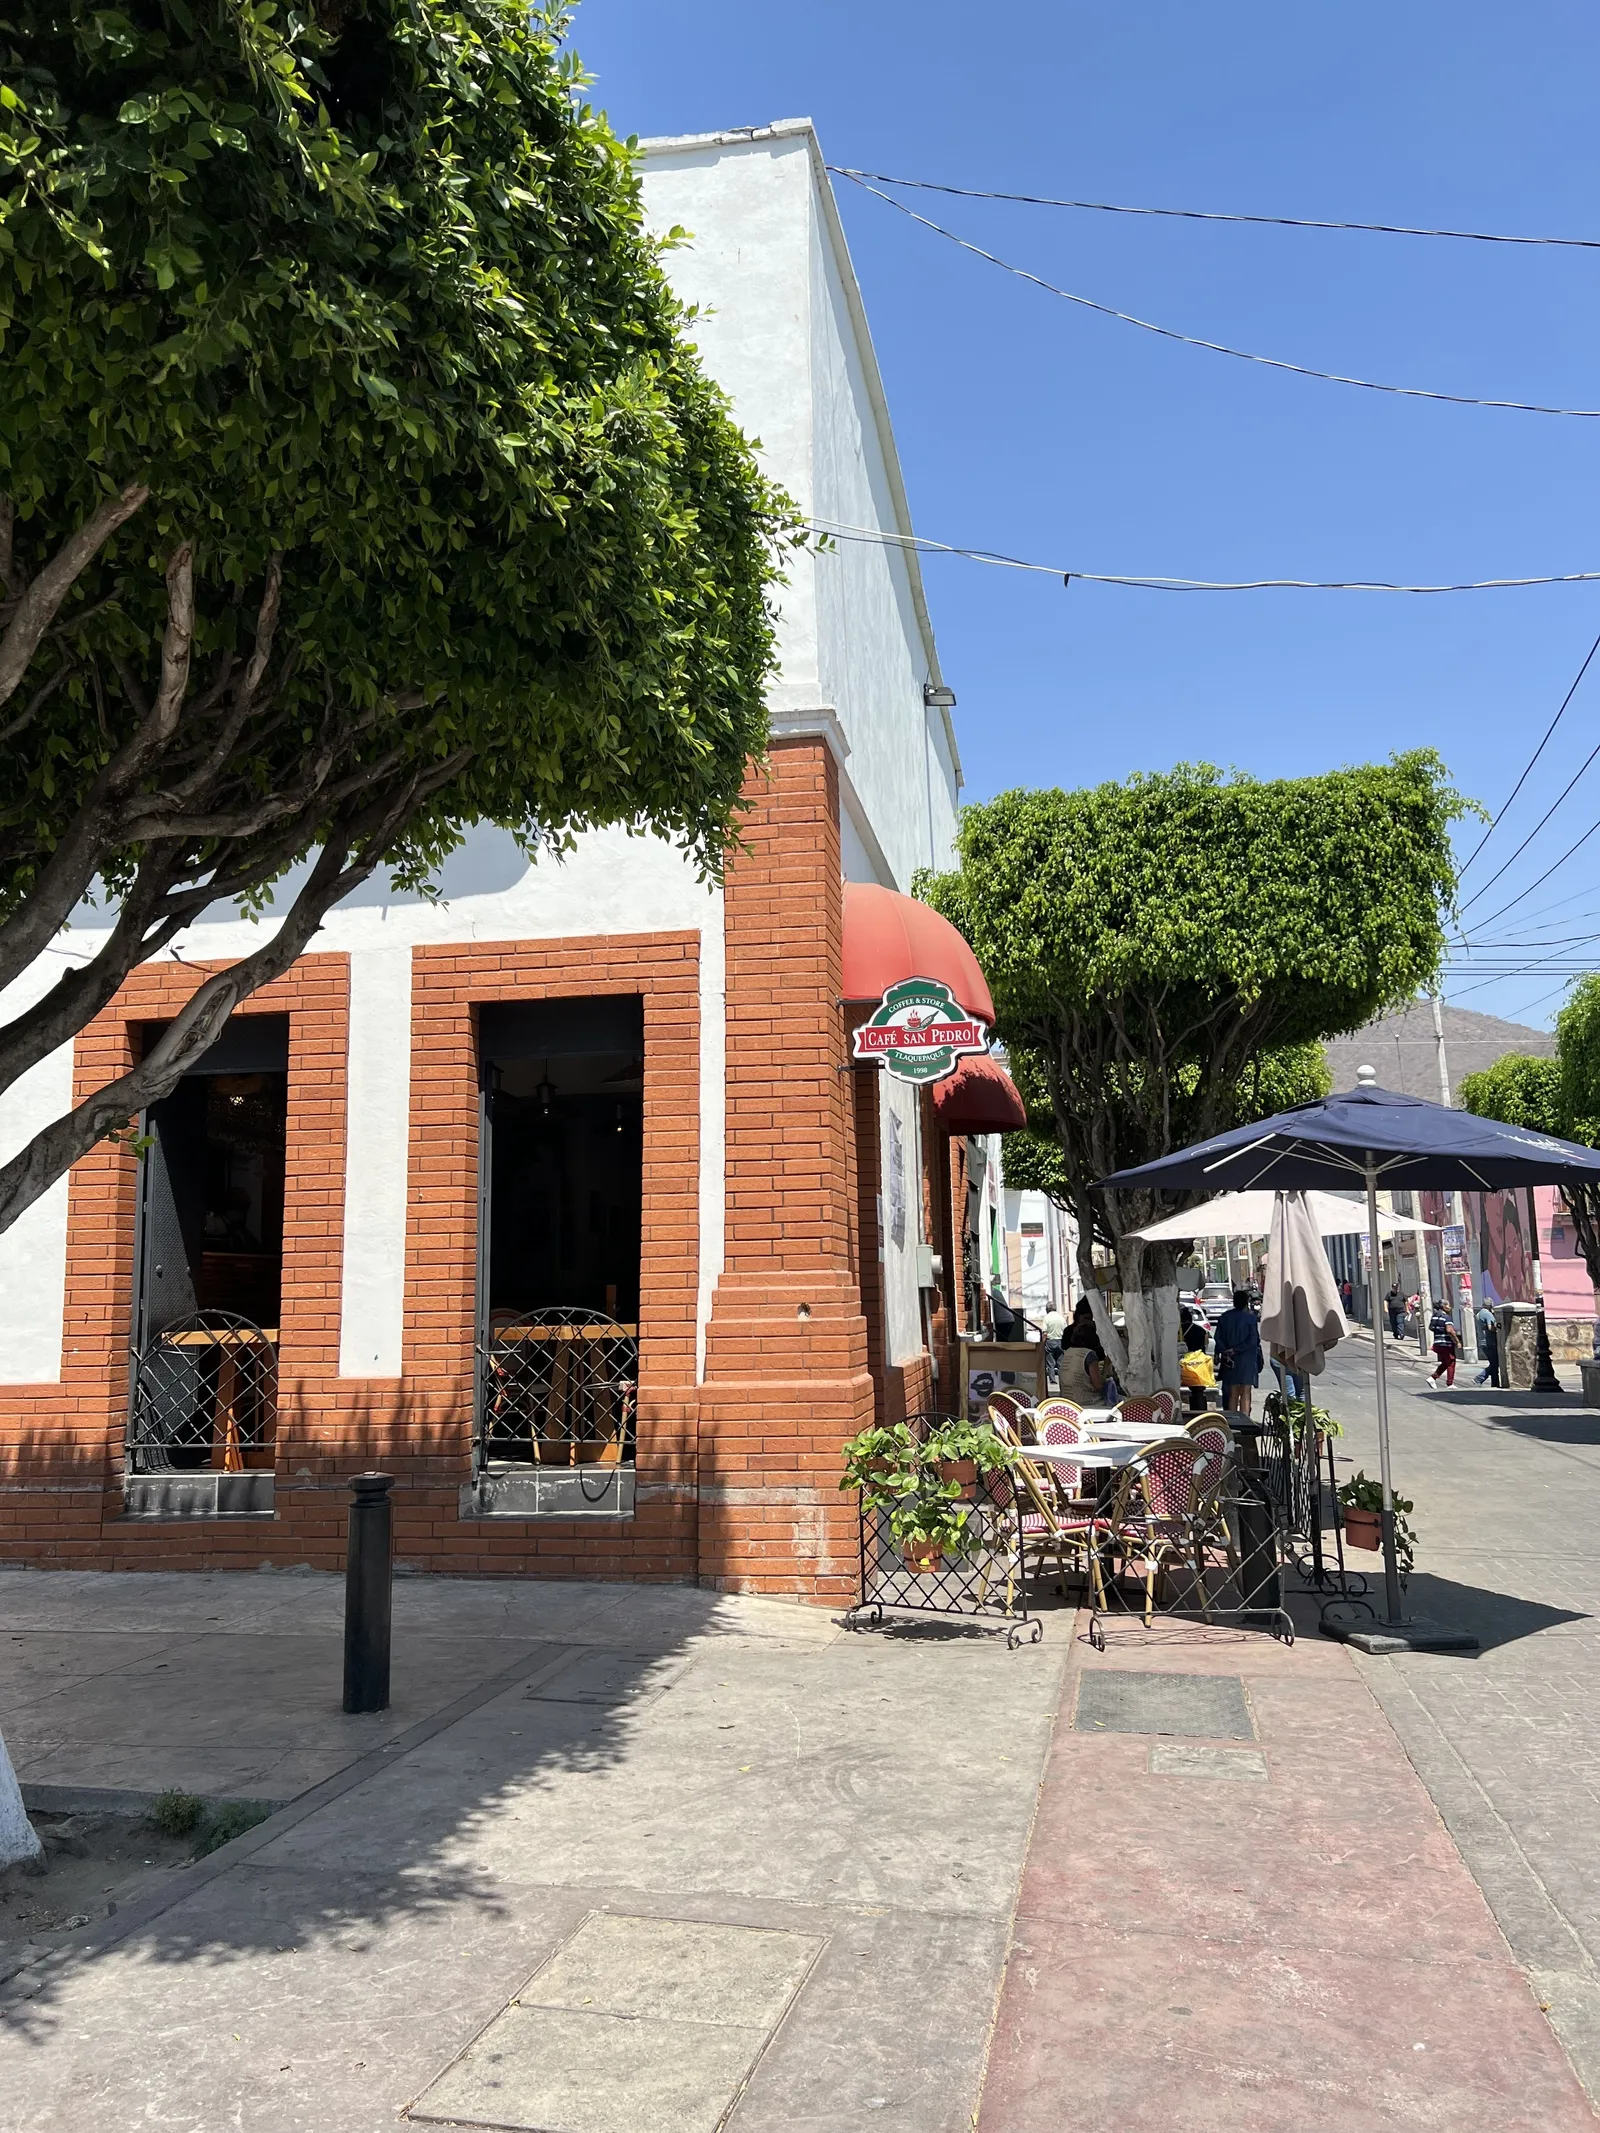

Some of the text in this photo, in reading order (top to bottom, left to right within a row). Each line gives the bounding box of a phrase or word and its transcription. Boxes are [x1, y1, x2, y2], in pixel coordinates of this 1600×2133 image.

[888, 998, 914, 1013] COFFEE
[922, 998, 945, 1009] STORE
[868, 1028, 971, 1046] CAFÉ SAN PEDRO
[895, 1049, 946, 1063] TLAQUEPAQUE
